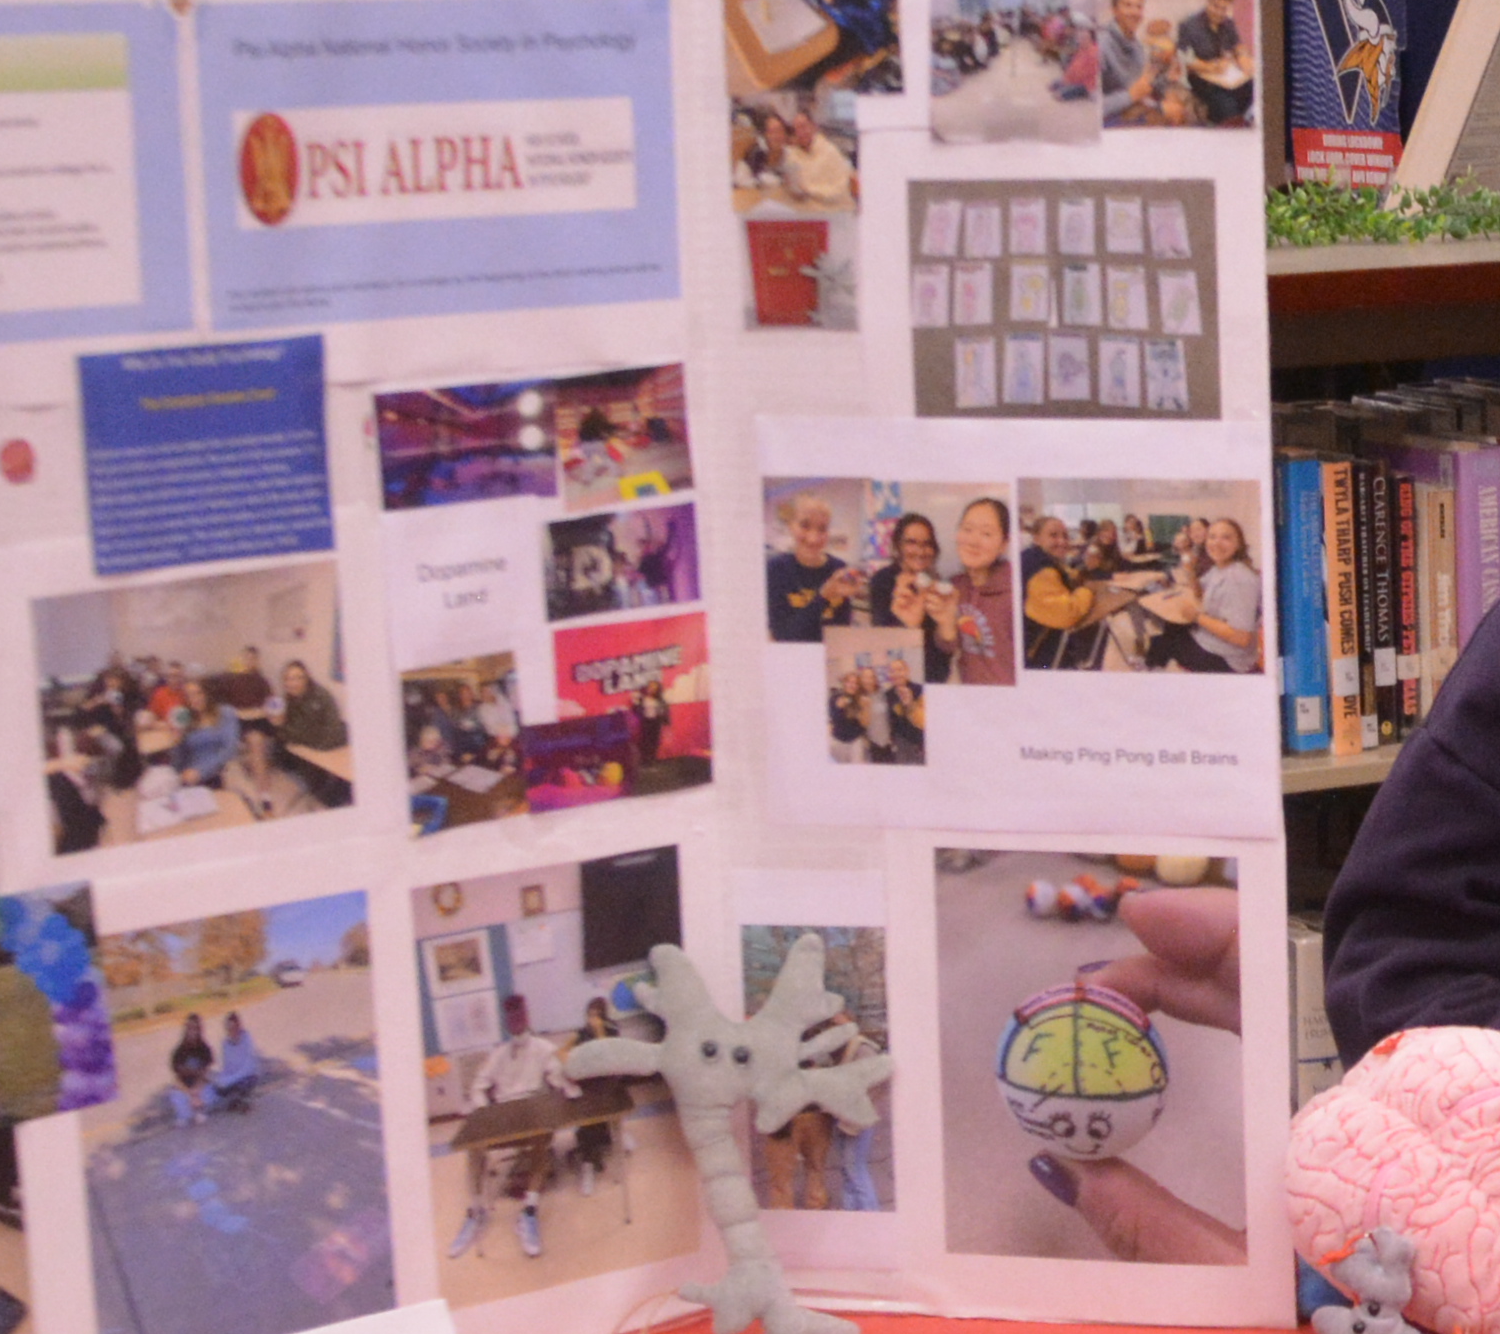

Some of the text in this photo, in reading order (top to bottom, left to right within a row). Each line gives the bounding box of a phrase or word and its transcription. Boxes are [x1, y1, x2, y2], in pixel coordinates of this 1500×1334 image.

[306, 140, 370, 199] PSI
[380, 134, 526, 196] ALPHA
[1334, 468, 1349, 515] TWYLA
[1336, 520, 1352, 566] THARP
[1373, 476, 1390, 642] CLARENCE THOMAS
[1339, 571, 1355, 606] PUSH
[1340, 610, 1357, 655] COMES
[1020, 746, 1239, 767] Making Ping Pong Ball Brains
